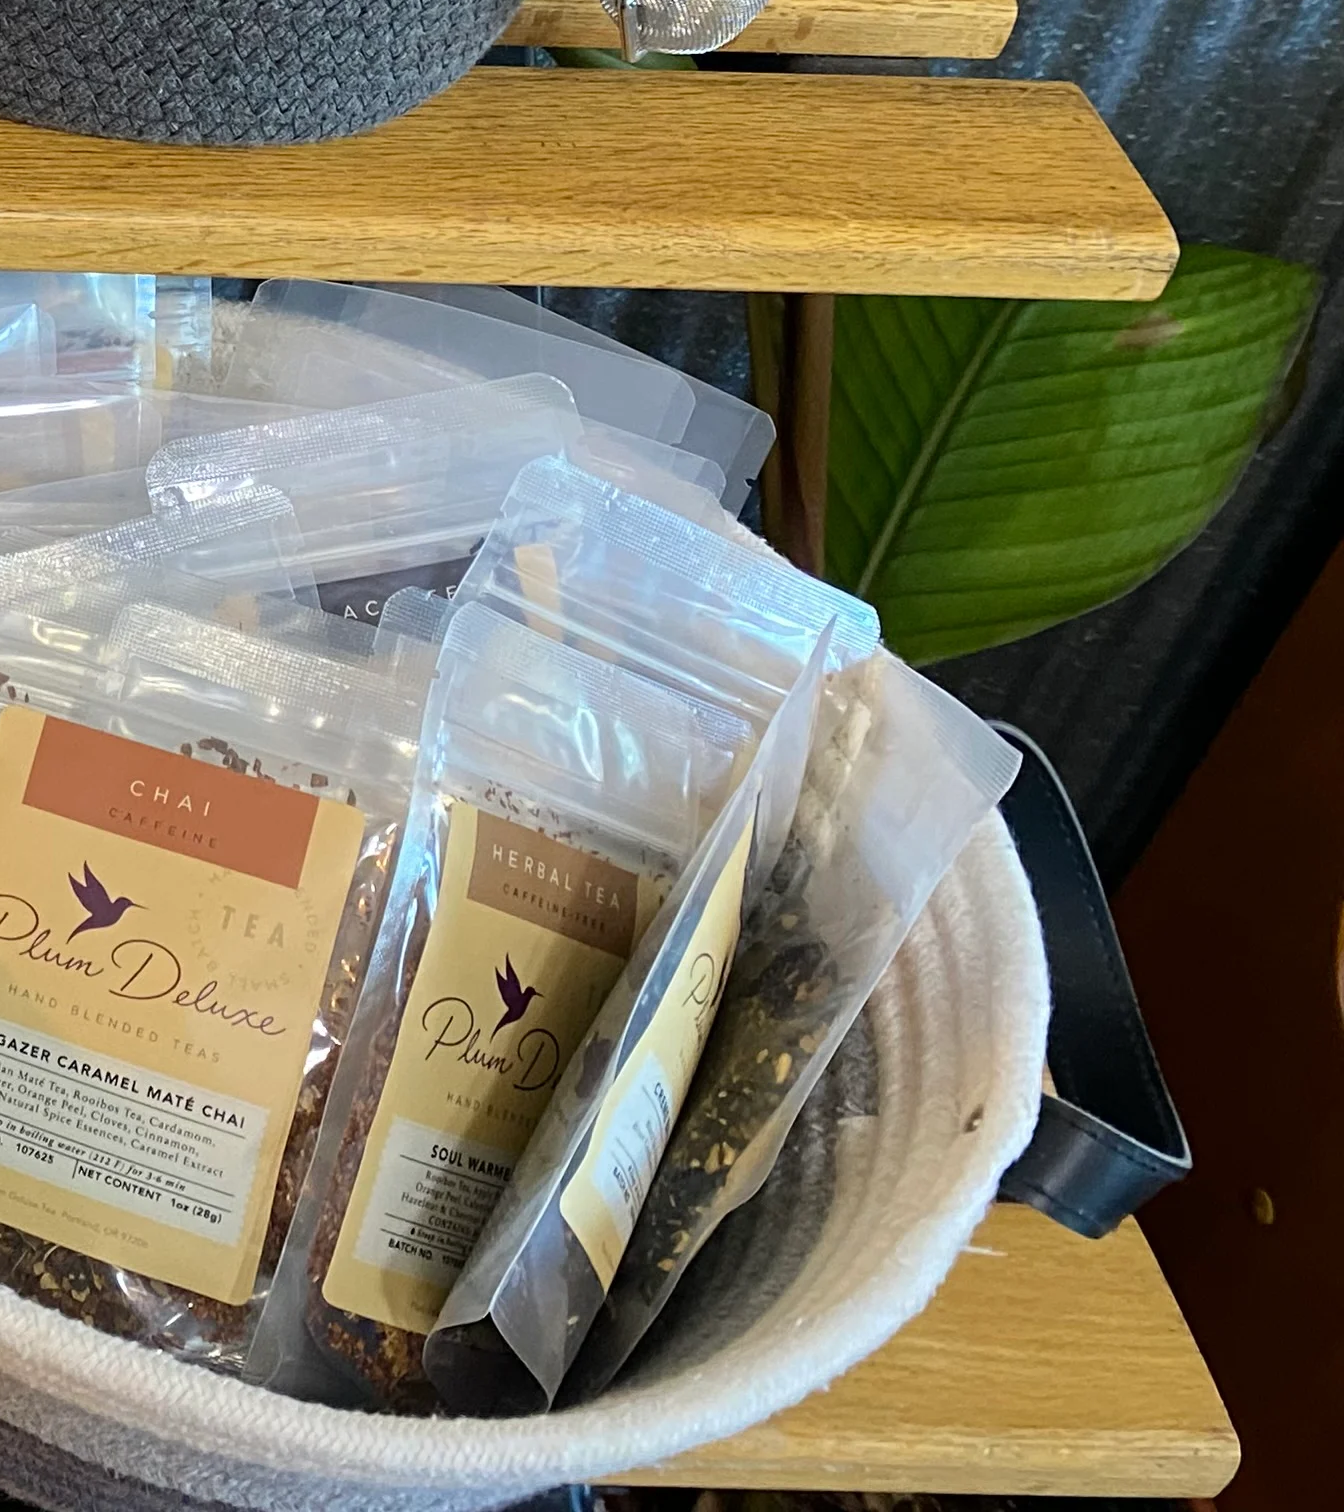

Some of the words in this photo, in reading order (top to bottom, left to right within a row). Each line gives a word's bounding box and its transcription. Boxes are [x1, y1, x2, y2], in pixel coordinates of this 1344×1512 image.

[108, 807, 218, 850] CAFFEINE
[130, 780, 212, 817] CHAI
[492, 844, 572, 893] HERBAL
[584, 880, 621, 911] TEA
[502, 883, 607, 935] CAFFEINE-FREE
[221, 905, 287, 949] TEA
[108, 939, 287, 1036] Deluxe
[8, 983, 58, 1010] HAND
[71, 1003, 159, 1044] BLENDED
[172, 1039, 221, 1064] TEAS
[422, 997, 514, 1074] Plum
[17, 1083, 57, 1105] Orange
[61, 1099, 86, 1118] Peel,
[91, 1110, 131, 1133] Cloves,
[135, 1126, 199, 1156] Cinnamon,
[18, 1068, 46, 1087] Maté
[49, 1079, 70, 1097] Tea,
[73, 1090, 119, 1114] Rooibos
[124, 1105, 146, 1124] Tea,
[149, 1117, 216, 1147] Cardamom,
[57, 1056, 140, 1094] CARAMEL
[146, 1085, 195, 1111] MATÉ
[202, 1105, 246, 1128] CHAI
[446, 1092, 481, 1110] HAND
[6, 1119, 17, 1132] in
[19, 1124, 54, 1148] boiling
[57, 1141, 86, 1157] water
[125, 1165, 143, 1177] for
[165, 1178, 187, 1192] min
[43, 1107, 72, 1126] Spice
[76, 1118, 127, 1147] Essences,
[131, 1139, 178, 1163] Caramel
[183, 1156, 224, 1178] Extract
[431, 1144, 463, 1167] SOUL
[16, 1143, 54, 1165] 107625
[78, 1165, 102, 1181] NET
[104, 1174, 162, 1202] CONTENT
[170, 1198, 190, 1212] 1oz
[192, 1205, 223, 1224] (28g)
[388, 1239, 417, 1255] BATCH
